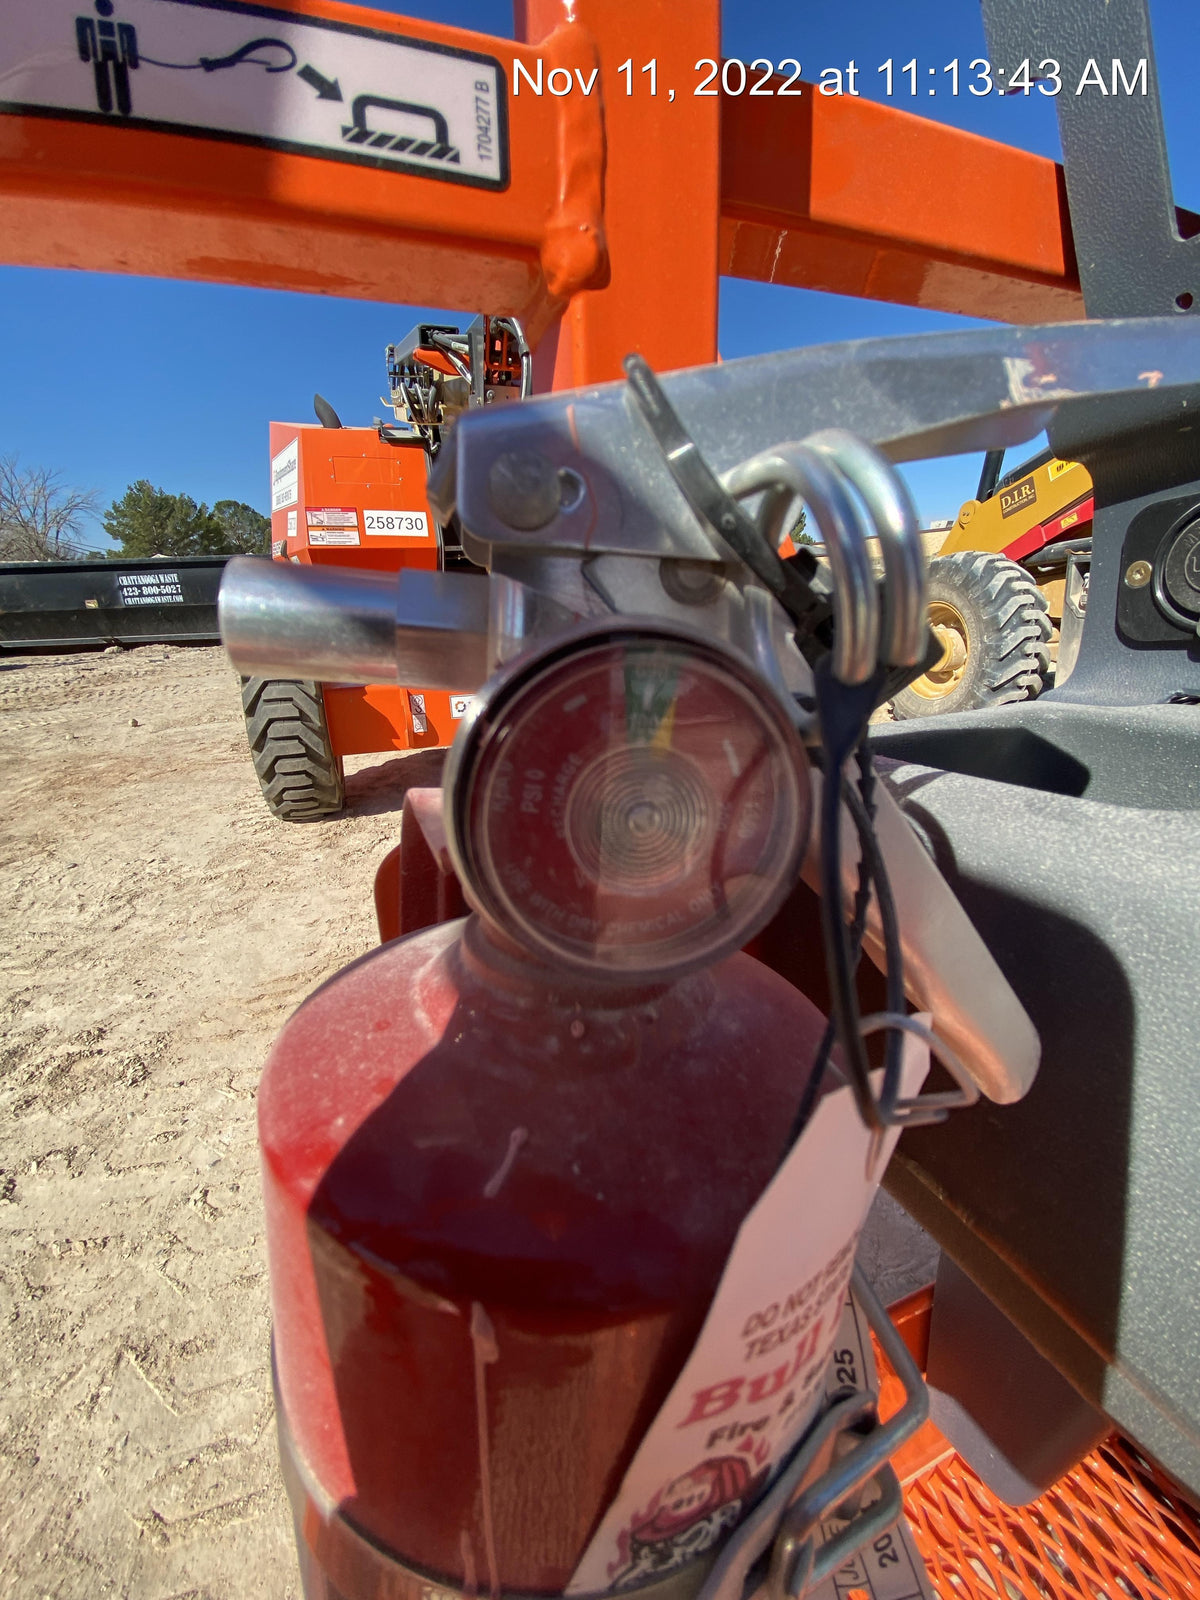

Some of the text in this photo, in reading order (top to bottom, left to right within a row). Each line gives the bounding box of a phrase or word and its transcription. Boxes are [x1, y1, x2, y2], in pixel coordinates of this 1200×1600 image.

[474, 80, 492, 161] 1704277 B
[1001, 484, 1035, 510] D.I.R.
[365, 516, 424, 531] 258730
[118, 573, 179, 586] CHATTANOOGA WASTE
[142, 584, 181, 595] 800-5027
